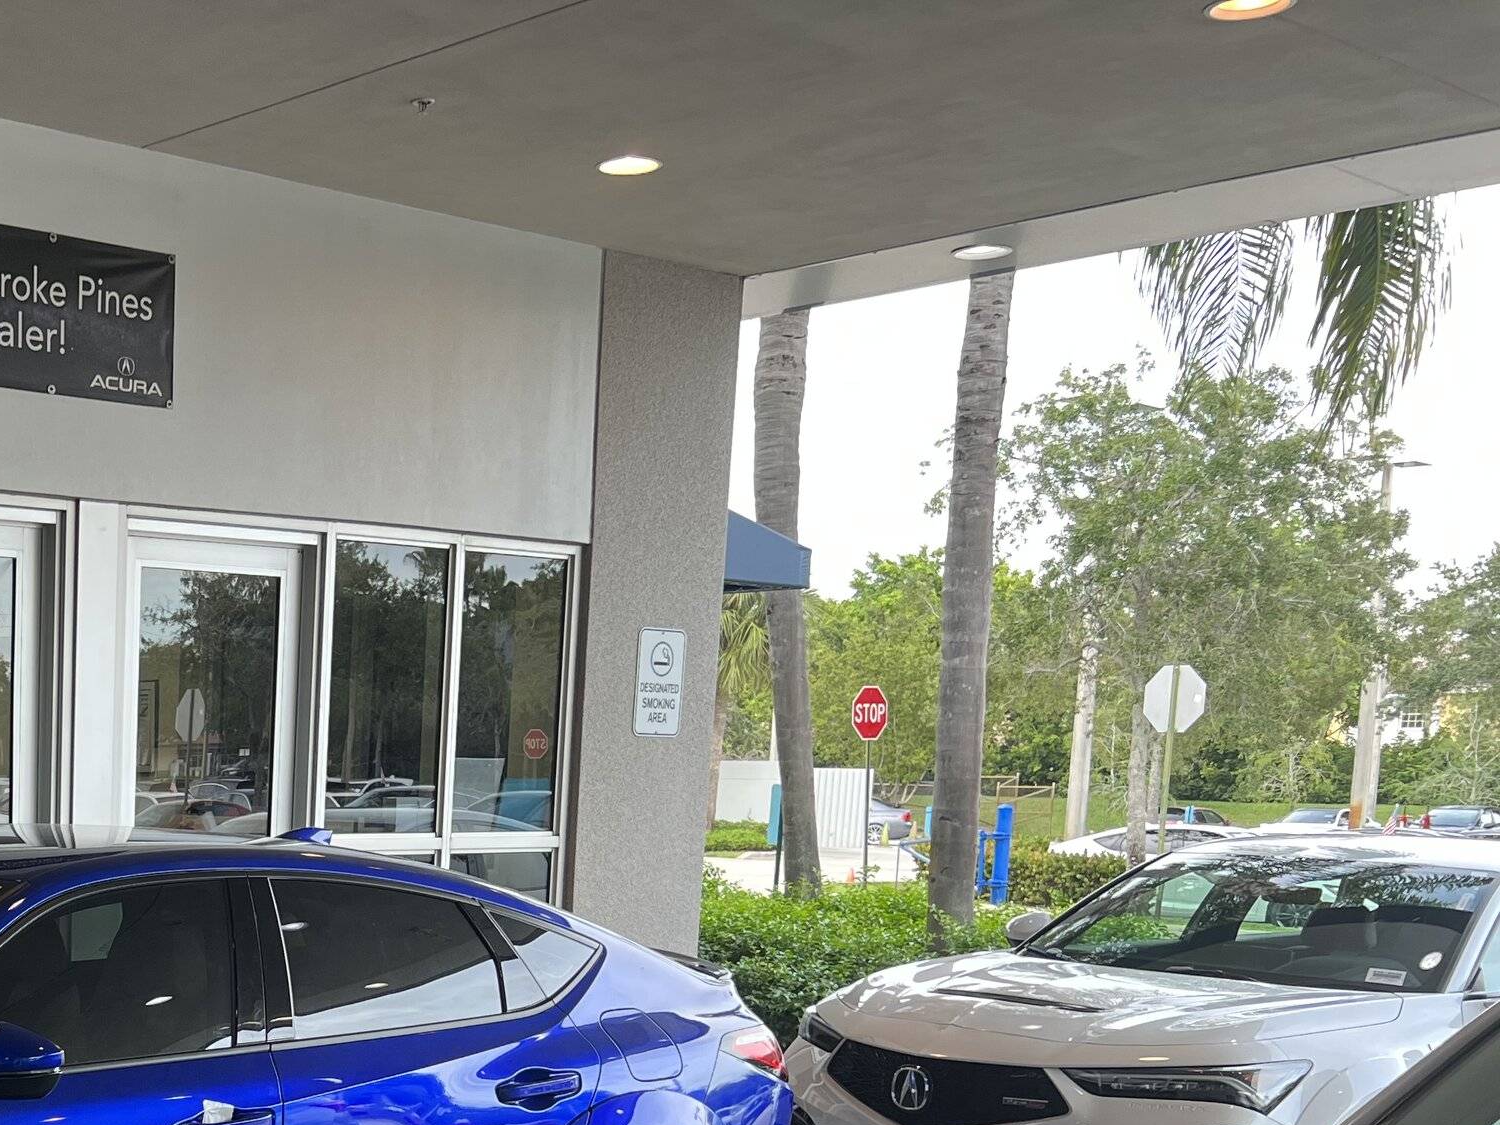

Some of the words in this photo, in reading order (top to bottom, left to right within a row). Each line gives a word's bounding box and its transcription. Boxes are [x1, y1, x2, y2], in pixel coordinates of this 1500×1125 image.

[78, 275, 154, 321] Pines
[89, 374, 163, 397] ACURA
[639, 682, 680, 694] DESIGNATED
[642, 697, 676, 710] SMOKING
[647, 712, 667, 723] AREA
[855, 703, 886, 724] STOP
